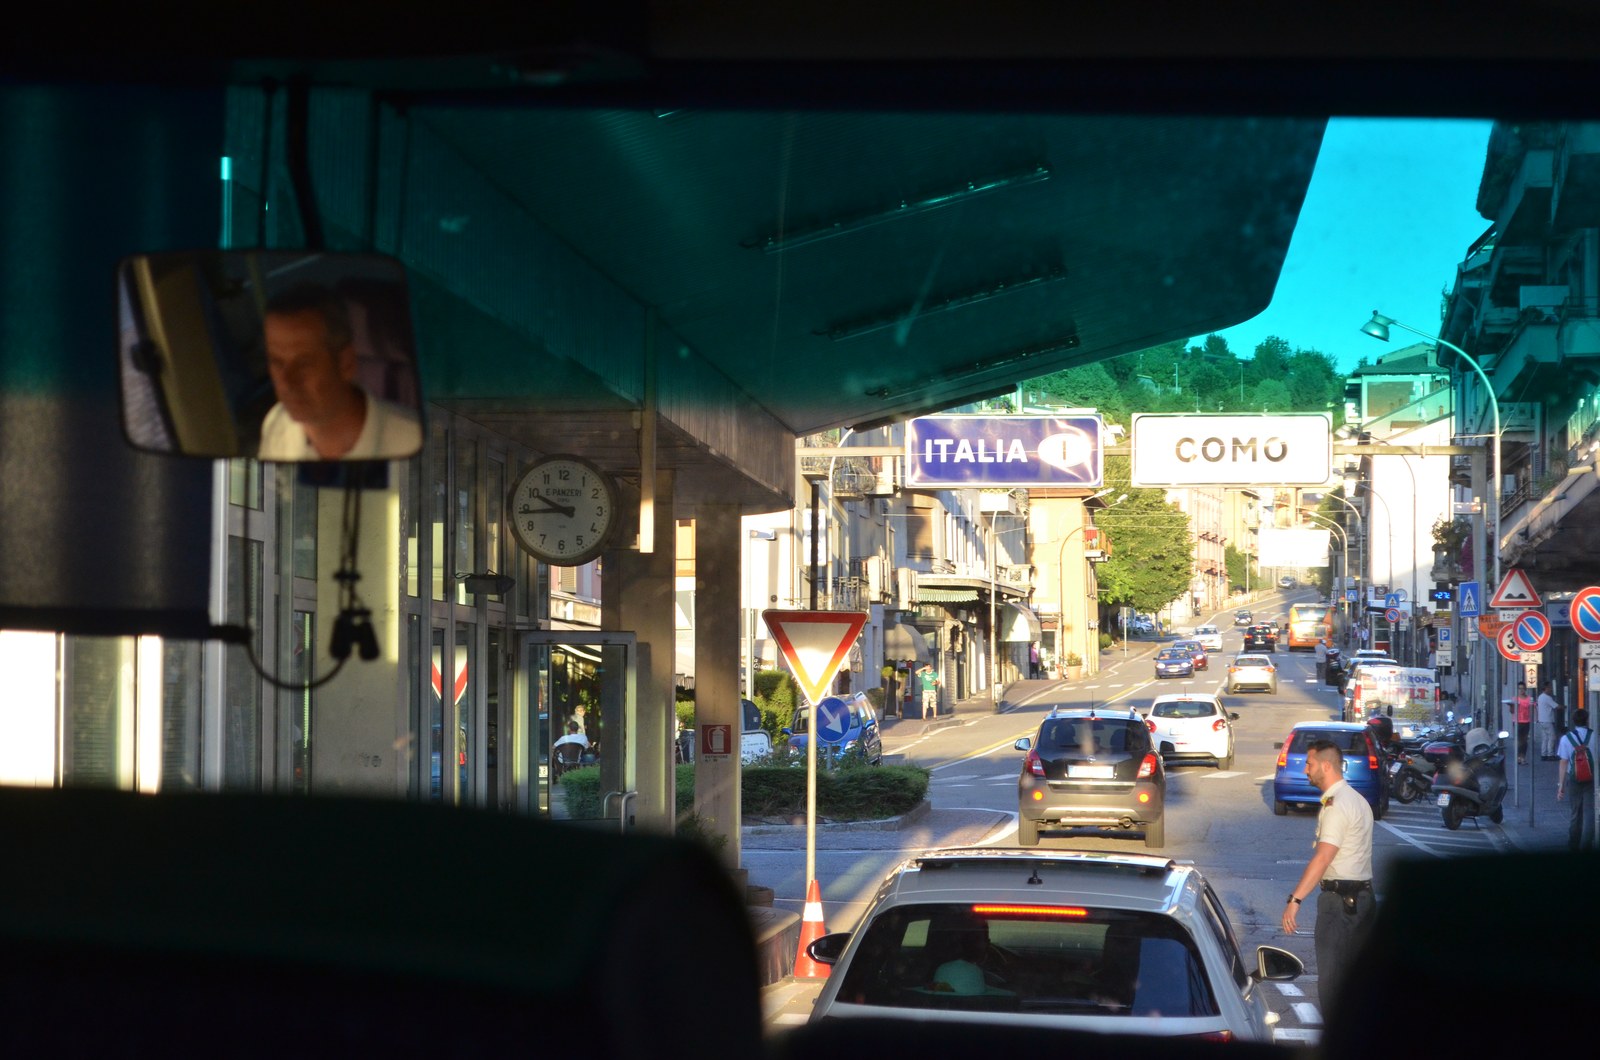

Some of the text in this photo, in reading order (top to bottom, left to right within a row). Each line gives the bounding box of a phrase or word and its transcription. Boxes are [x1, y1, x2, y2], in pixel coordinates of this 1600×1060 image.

[924, 438, 1028, 463] ITALIA
[1174, 436, 1289, 463] COMO
[543, 474, 550, 485] 11
[559, 470, 570, 480] 12
[582, 476, 585, 487] 1
[528, 488, 539, 498] 10
[591, 488, 599, 499] 2
[522, 504, 530, 514] 9
[596, 506, 603, 517] 3
[527, 521, 534, 531] 8
[590, 522, 597, 533] 4
[539, 534, 547, 545] 7
[558, 540, 565, 550] 6
[576, 535, 583, 546] 5
